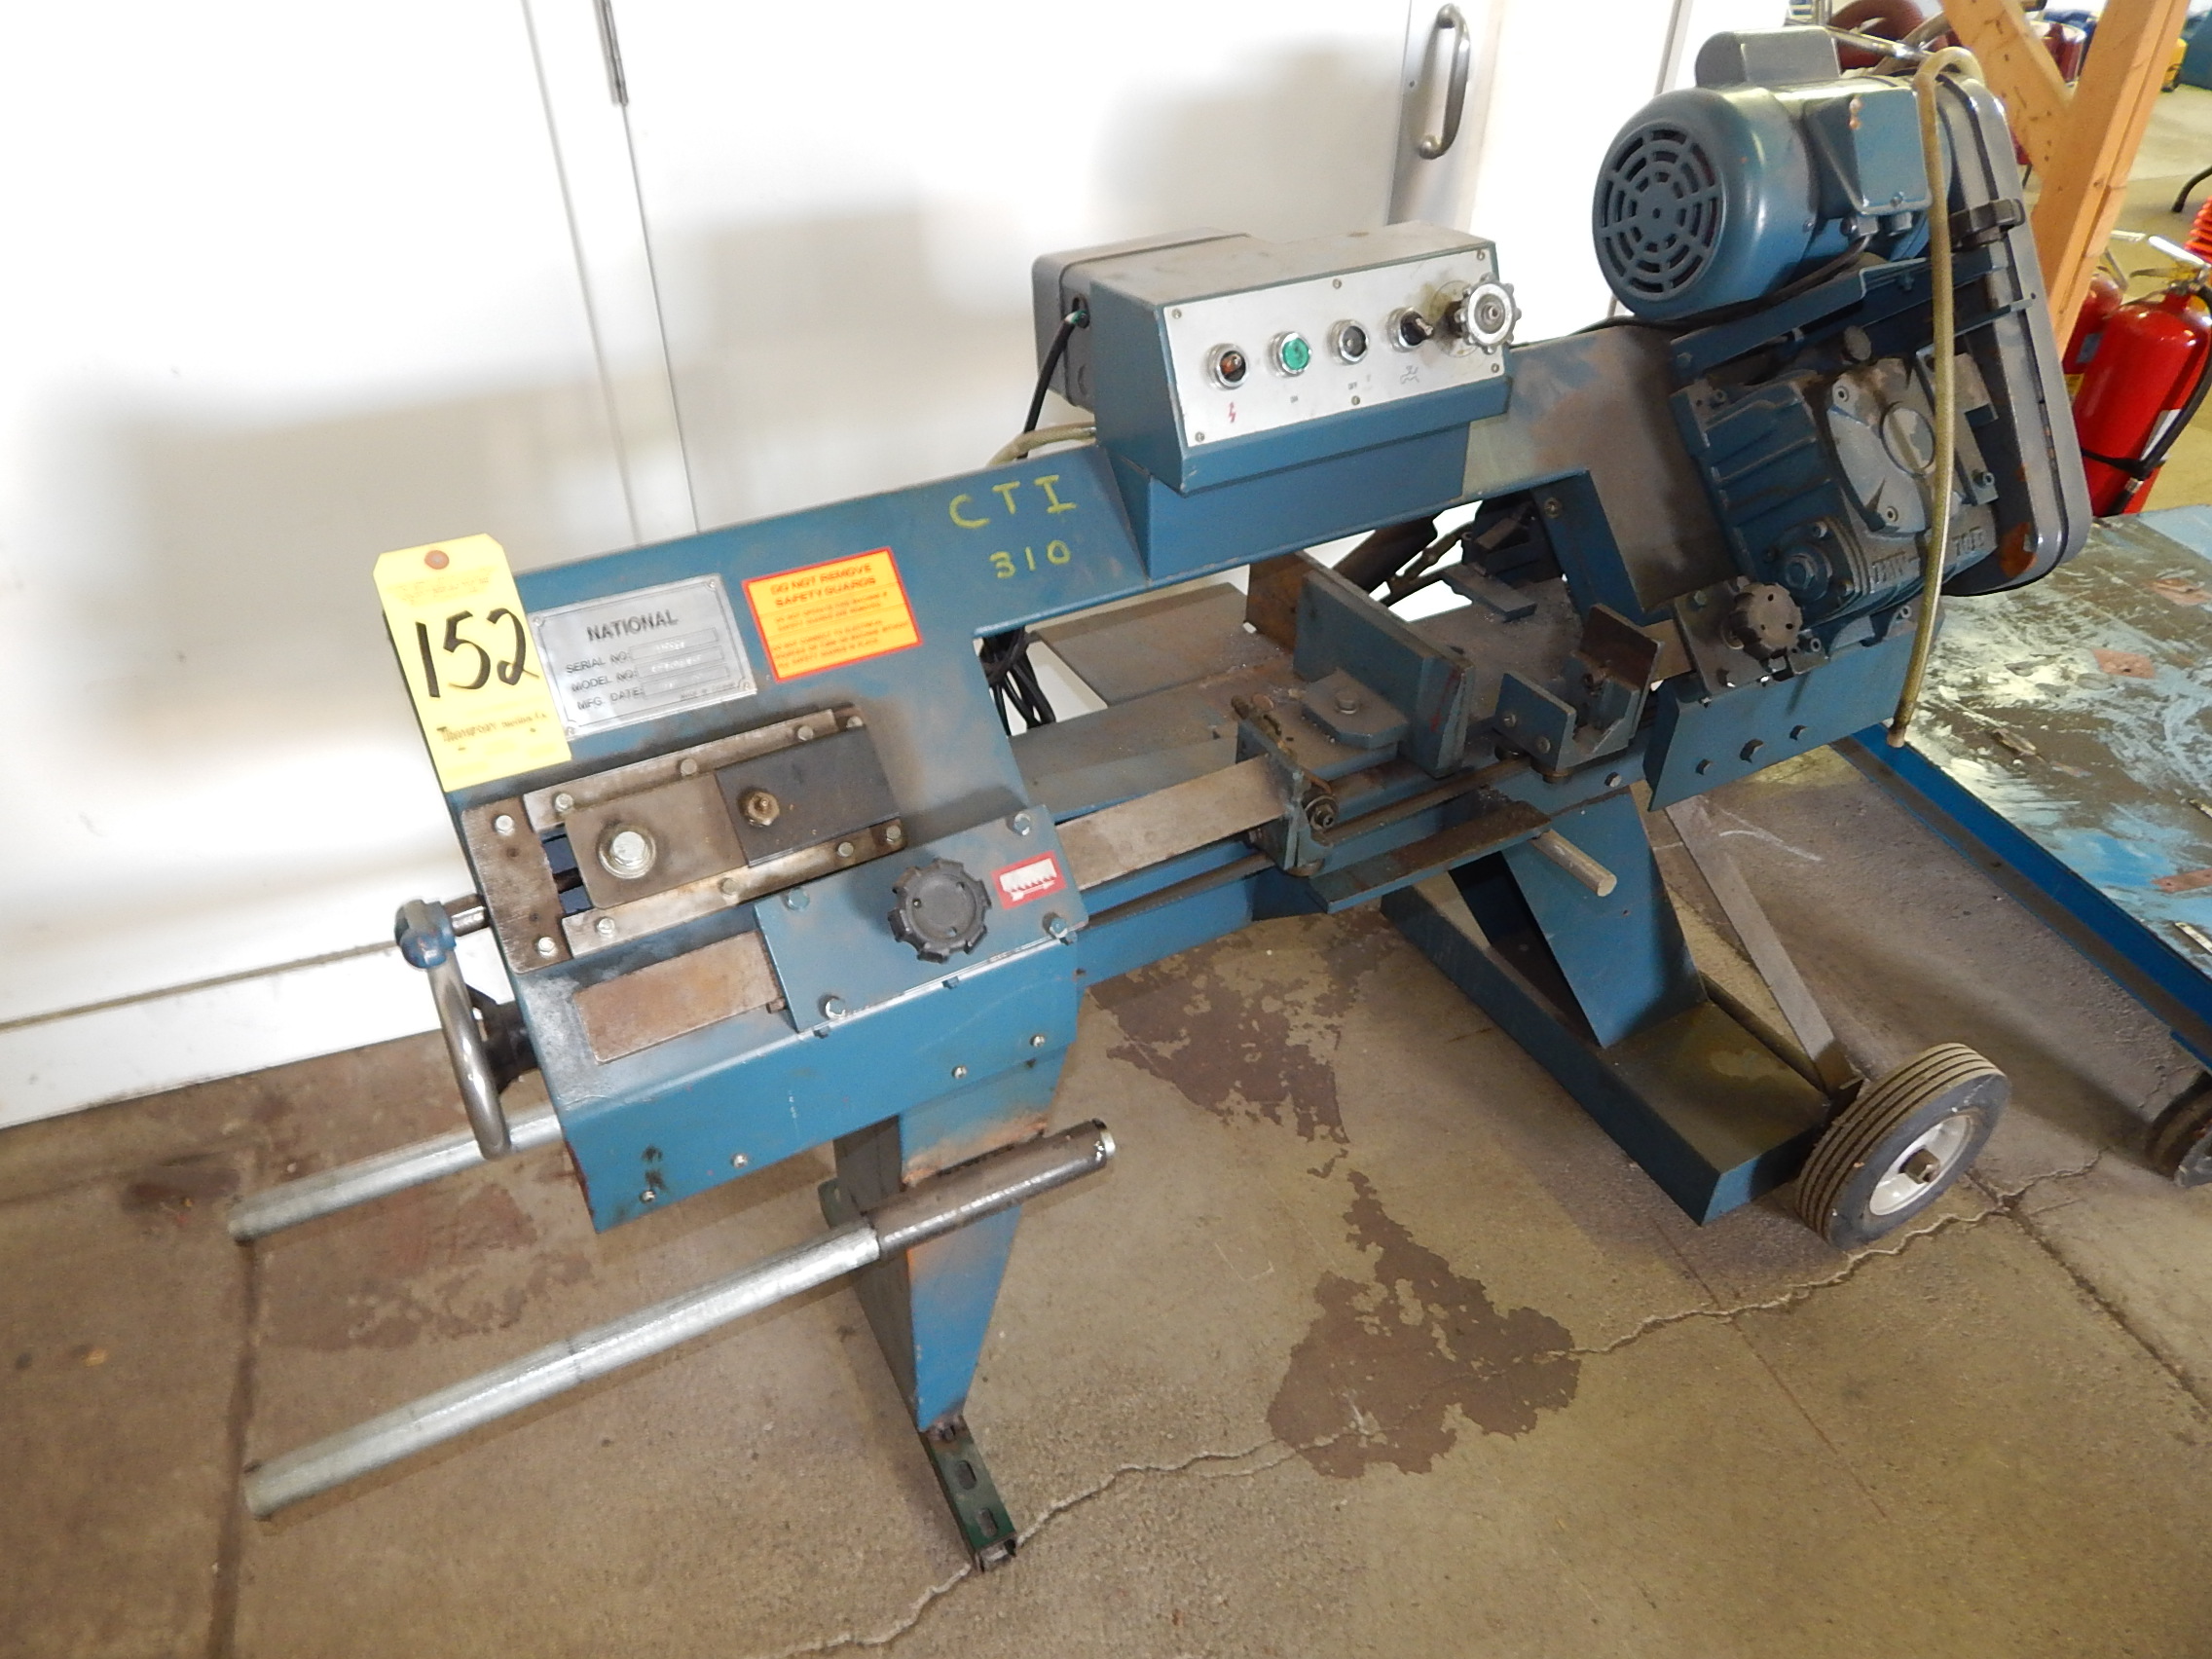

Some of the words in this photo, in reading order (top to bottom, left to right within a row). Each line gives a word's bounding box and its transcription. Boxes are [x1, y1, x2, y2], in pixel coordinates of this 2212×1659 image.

[820, 563, 872, 583] REMOVE
[989, 539, 1070, 578] 310
[775, 589, 823, 608] SAFETY
[825, 576, 876, 596] GUARDS
[586, 608, 679, 642] NATIONAL
[415, 608, 539, 699] 152
[566, 656, 607, 674] SERIAL
[571, 676, 611, 693] MODEL
